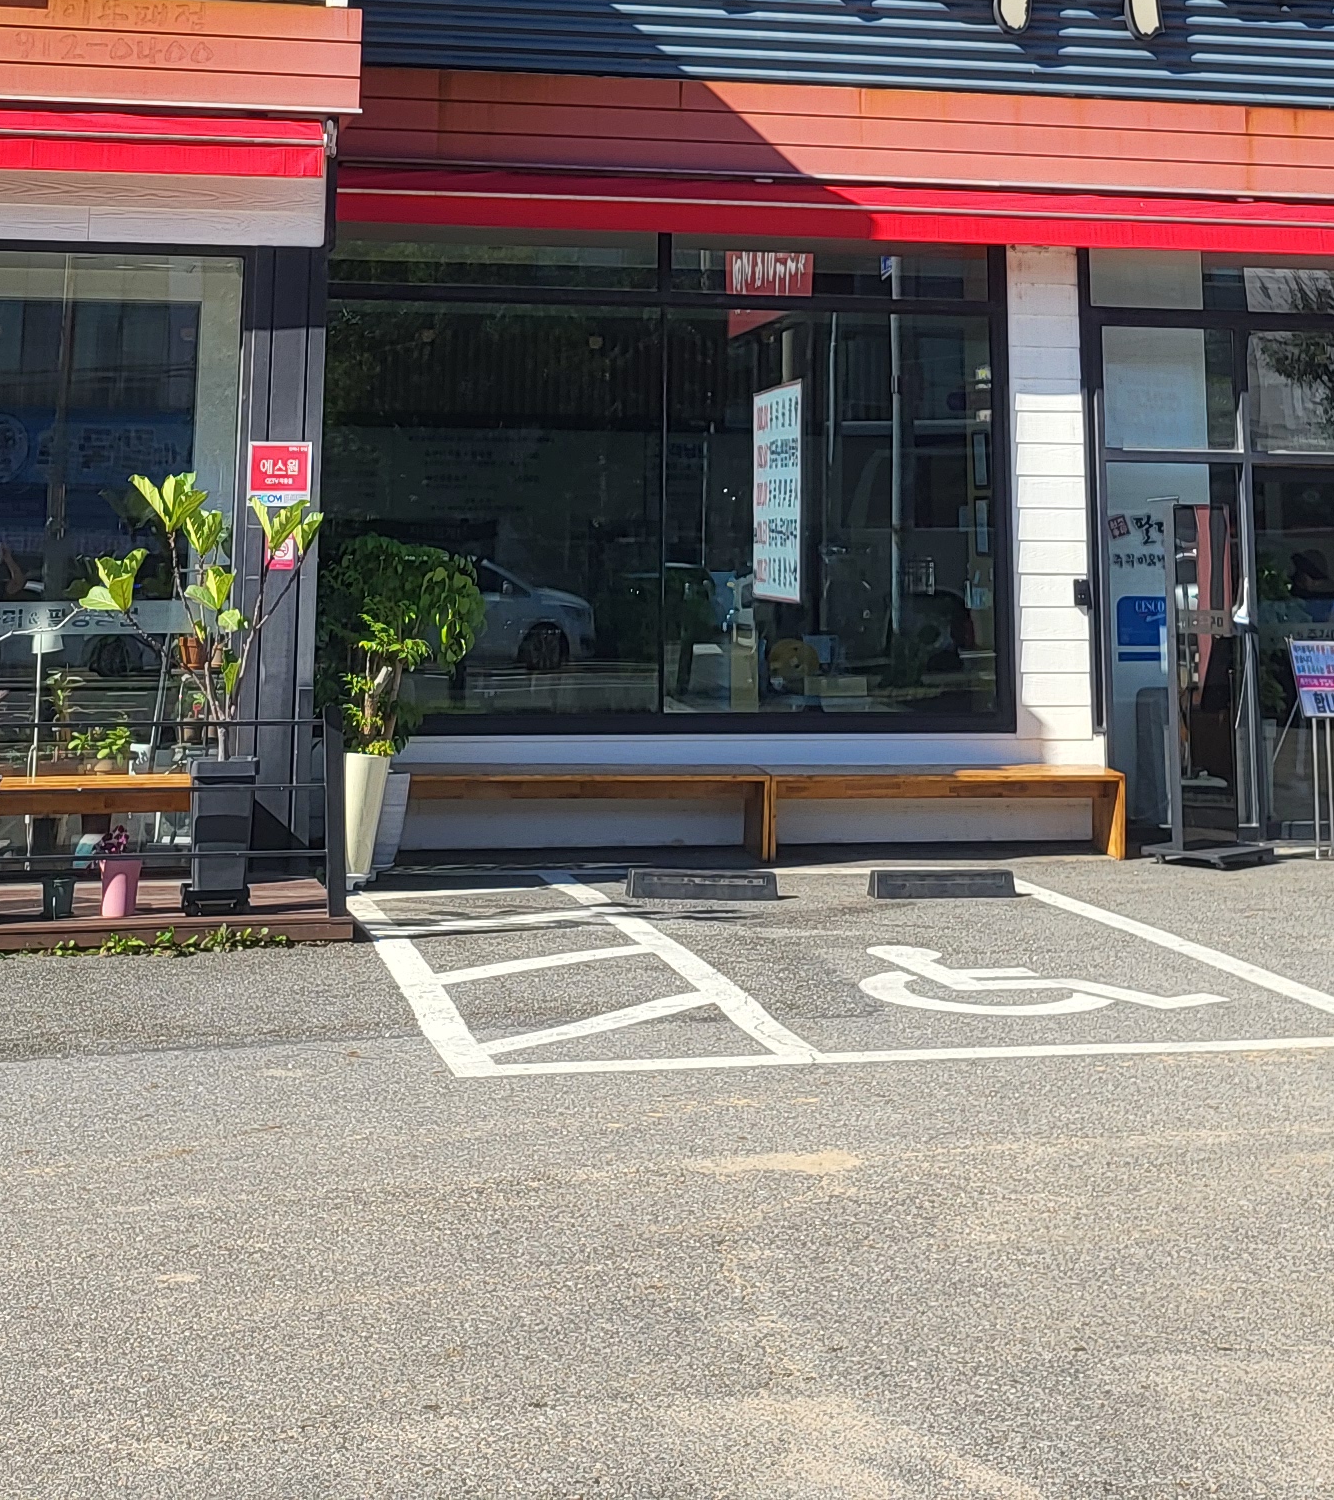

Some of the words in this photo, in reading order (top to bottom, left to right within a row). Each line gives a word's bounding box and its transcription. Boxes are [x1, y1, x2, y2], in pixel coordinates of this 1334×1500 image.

[15, 32, 215, 64] 912-0400
[260, 458, 299, 476] 에스원
[254, 494, 282, 503] COM
[1135, 600, 1165, 612] CESCO
